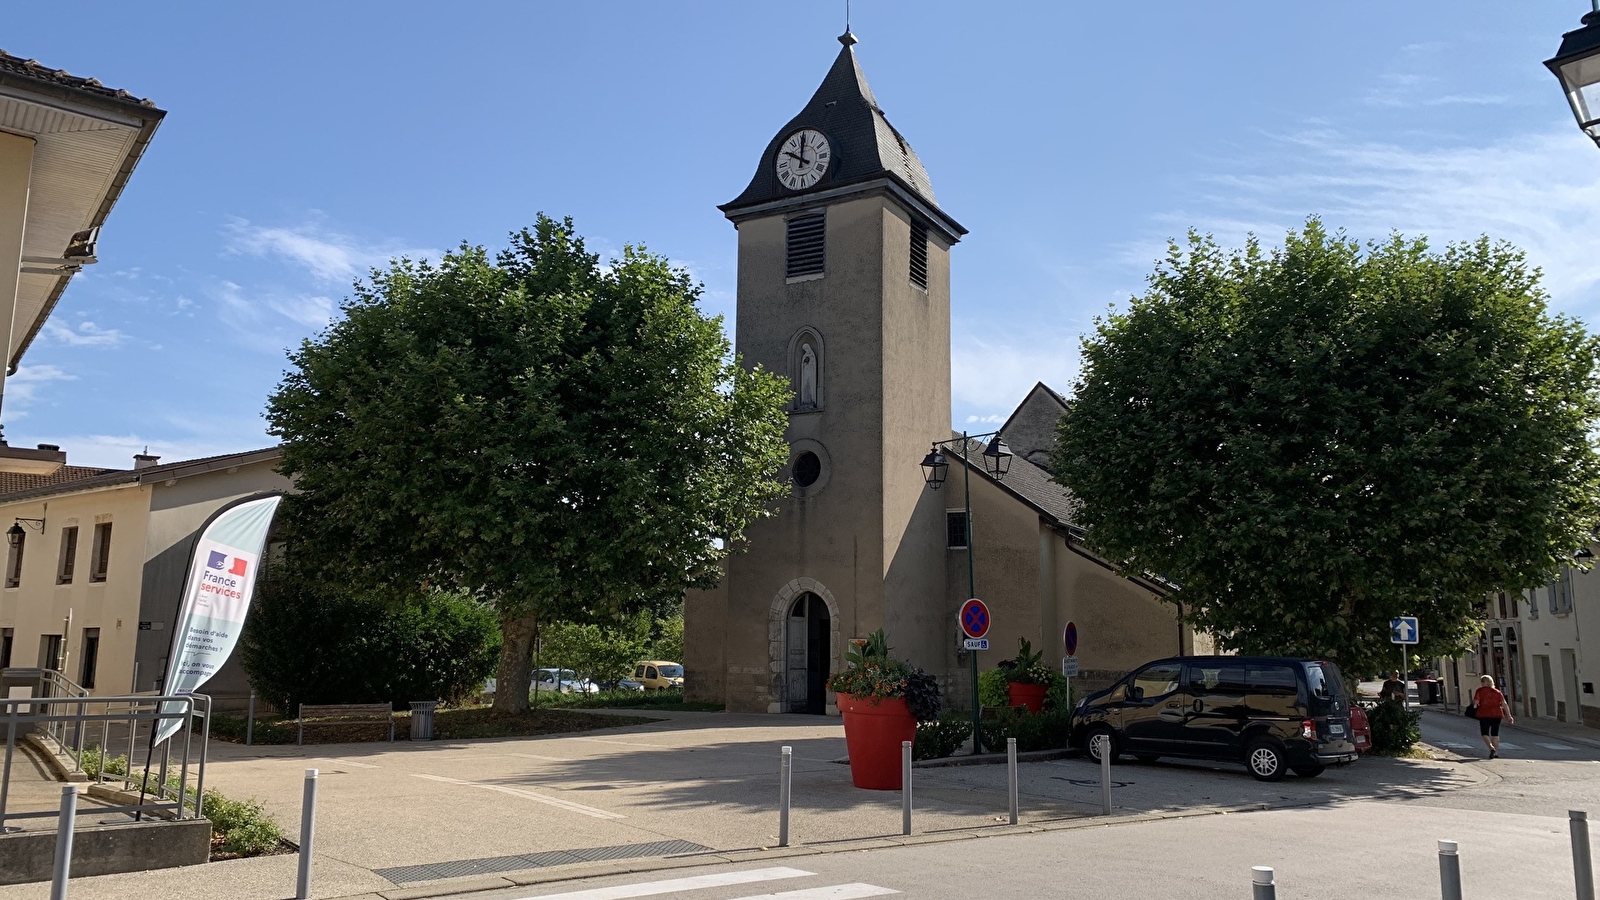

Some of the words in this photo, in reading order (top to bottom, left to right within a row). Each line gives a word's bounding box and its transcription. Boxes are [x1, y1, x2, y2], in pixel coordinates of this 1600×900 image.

[204, 570, 236, 588] France
[200, 582, 242, 600] services
[190, 626, 209, 636] Besoin
[210, 630, 228, 638] d'aide
[186, 643, 218, 652] démarches
